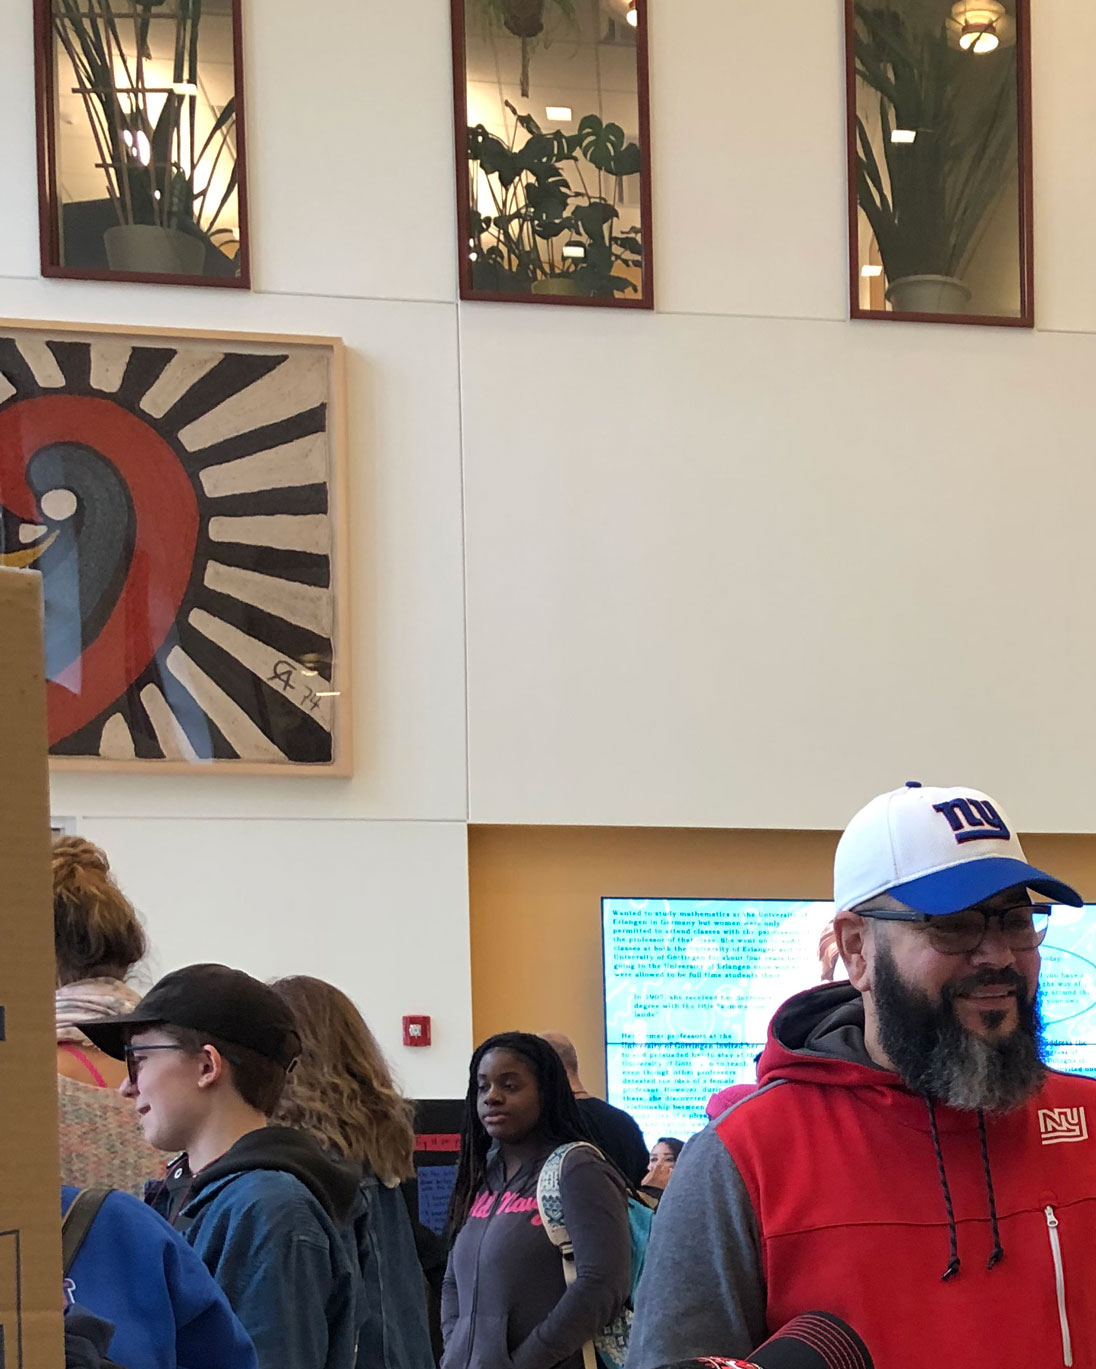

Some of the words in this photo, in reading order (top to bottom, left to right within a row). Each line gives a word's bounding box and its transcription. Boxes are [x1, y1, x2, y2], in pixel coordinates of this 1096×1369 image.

[612, 928, 652, 936] permitted
[634, 1002, 660, 1010] degree
[469, 1190, 498, 1219] ld
